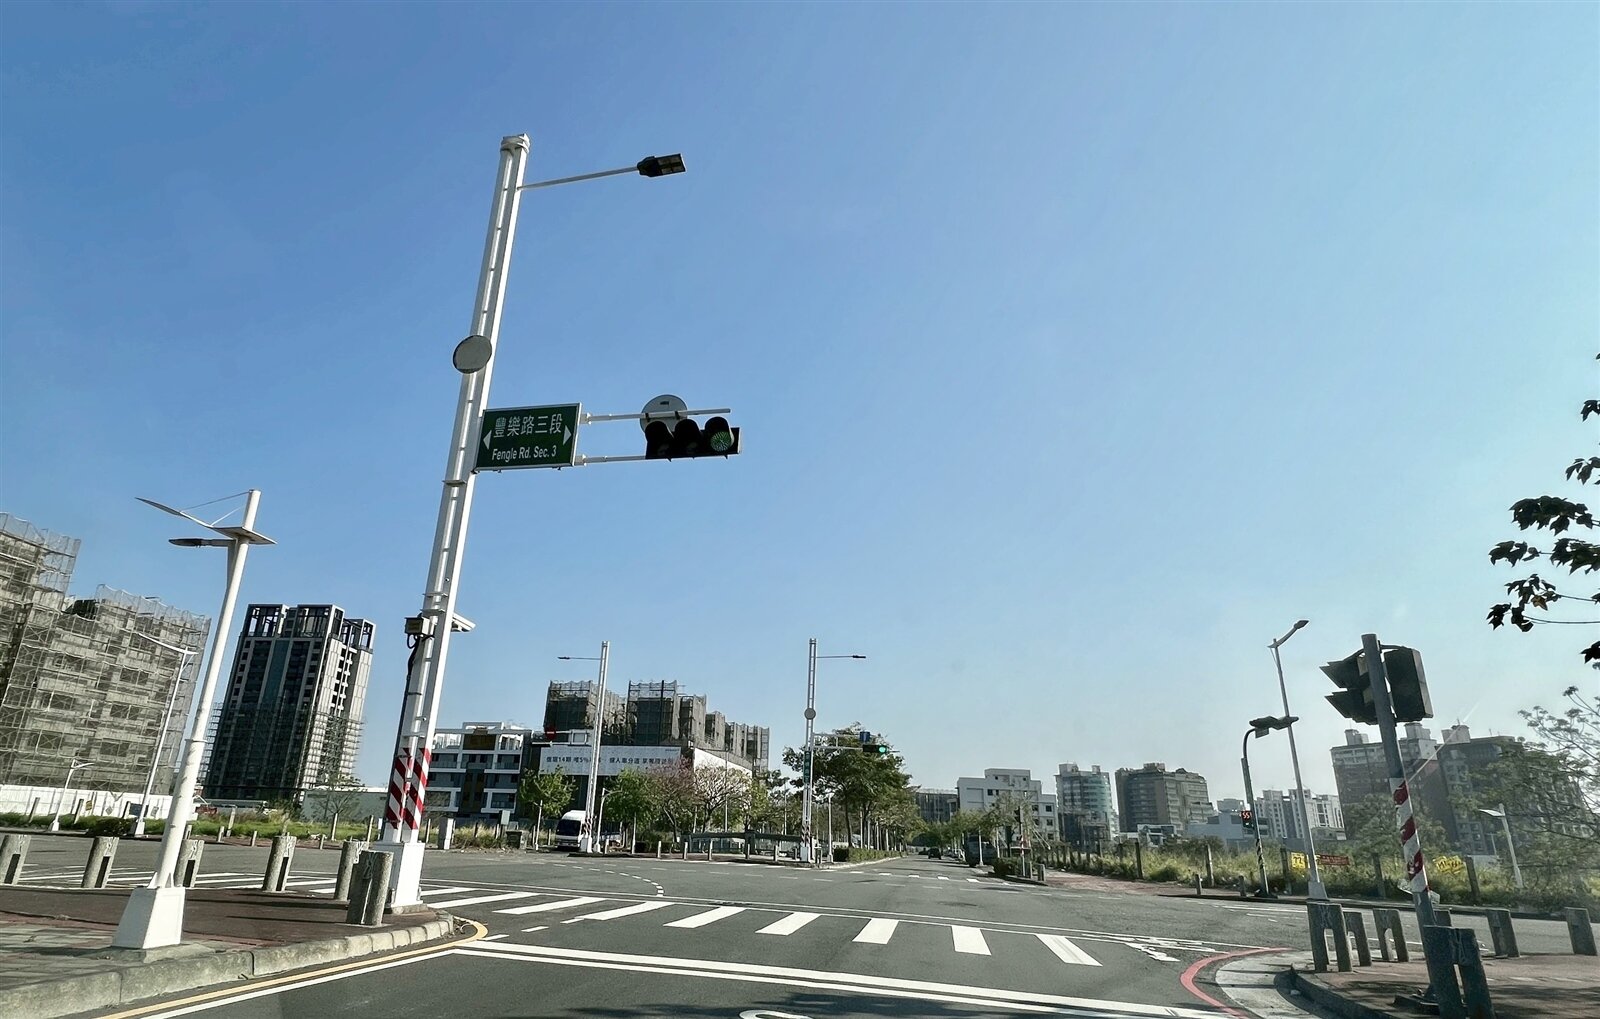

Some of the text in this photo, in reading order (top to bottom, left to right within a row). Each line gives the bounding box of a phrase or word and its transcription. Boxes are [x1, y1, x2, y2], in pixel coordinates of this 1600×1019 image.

[493, 413, 562, 438] 豐樂路三段
[491, 444, 557, 462] Fengle Rd. Sec. 3
